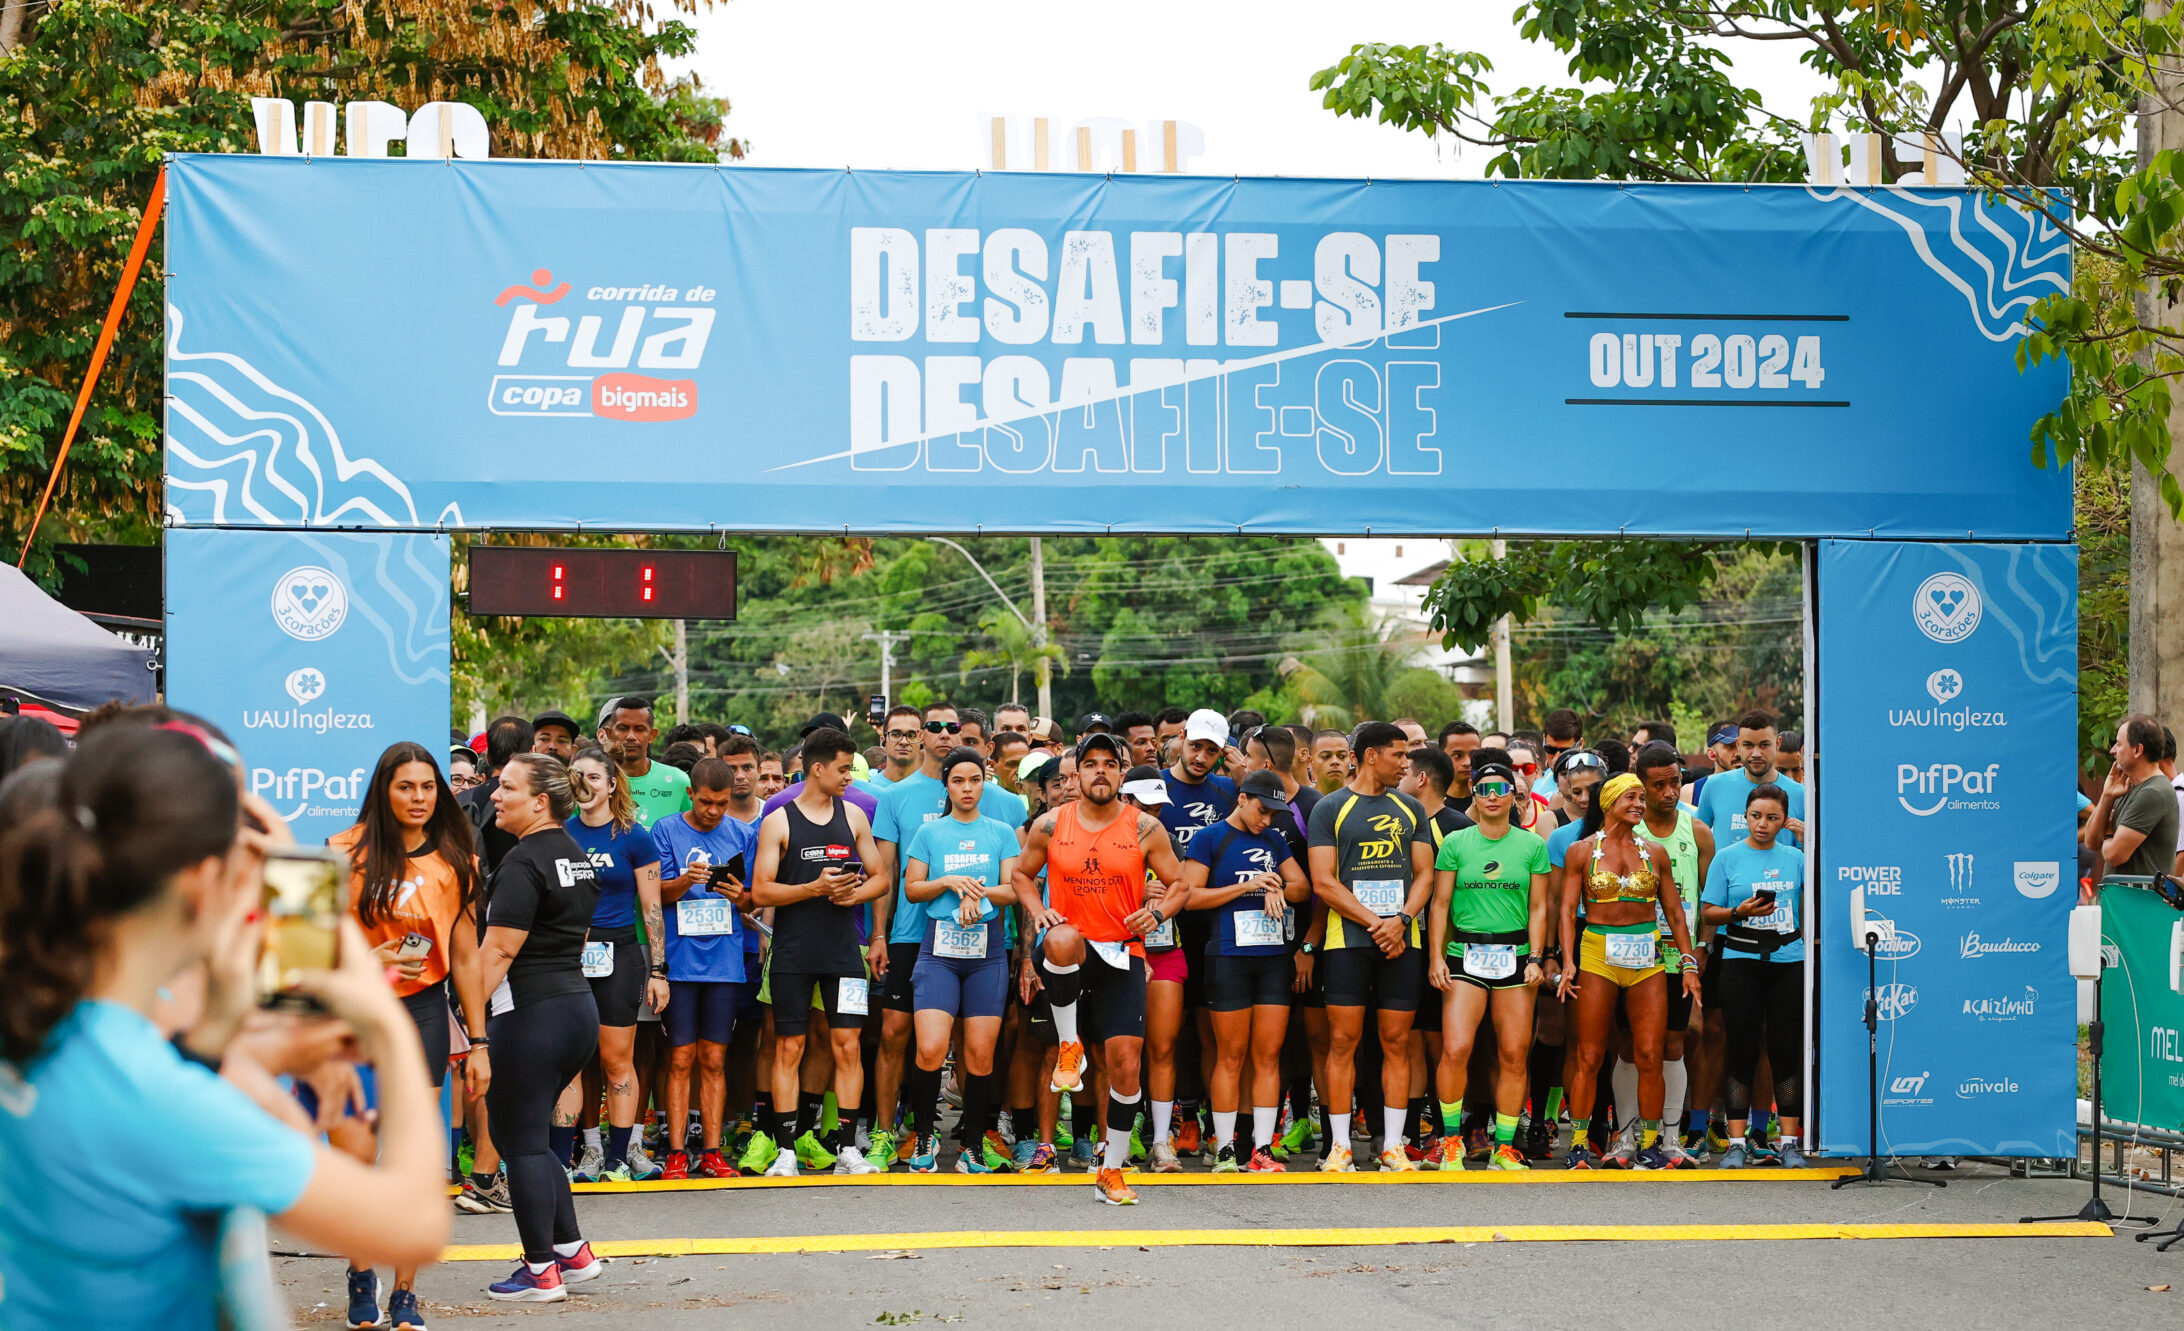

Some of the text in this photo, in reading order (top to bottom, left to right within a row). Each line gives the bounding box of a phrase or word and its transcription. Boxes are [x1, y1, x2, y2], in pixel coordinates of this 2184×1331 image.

[587, 284, 717, 302] corrida de
[850, 227, 1441, 349] DESAFIE-SE
[497, 303, 717, 370] rua
[1589, 332, 1825, 389] OUT 2024
[502, 385, 689, 412] copa bigmais
[850, 354, 1442, 475] DESAFIE-SE
[279, 606, 292, 616] 3
[1919, 610, 1931, 619] 3
[307, 803, 360, 817] alimento
[1947, 799, 2001, 810] alimentos
[1063, 876, 1106, 886] MENINOS
[1838, 866, 1902, 881] POWER
[2018, 871, 2056, 881] Colgate
[1463, 880, 1484, 889] bola
[1498, 881, 1521, 890] rede
[1867, 881, 1902, 896] ADE
[1360, 889, 1397, 904] 2609
[684, 907, 725, 924] 2530
[1242, 919, 1277, 934] 2763
[941, 930, 980, 947] 2562
[1960, 929, 2041, 959] Bauducco
[1612, 942, 1650, 957] 2730
[1470, 952, 1509, 968] 2720
[1960, 1077, 2019, 1094] univale
